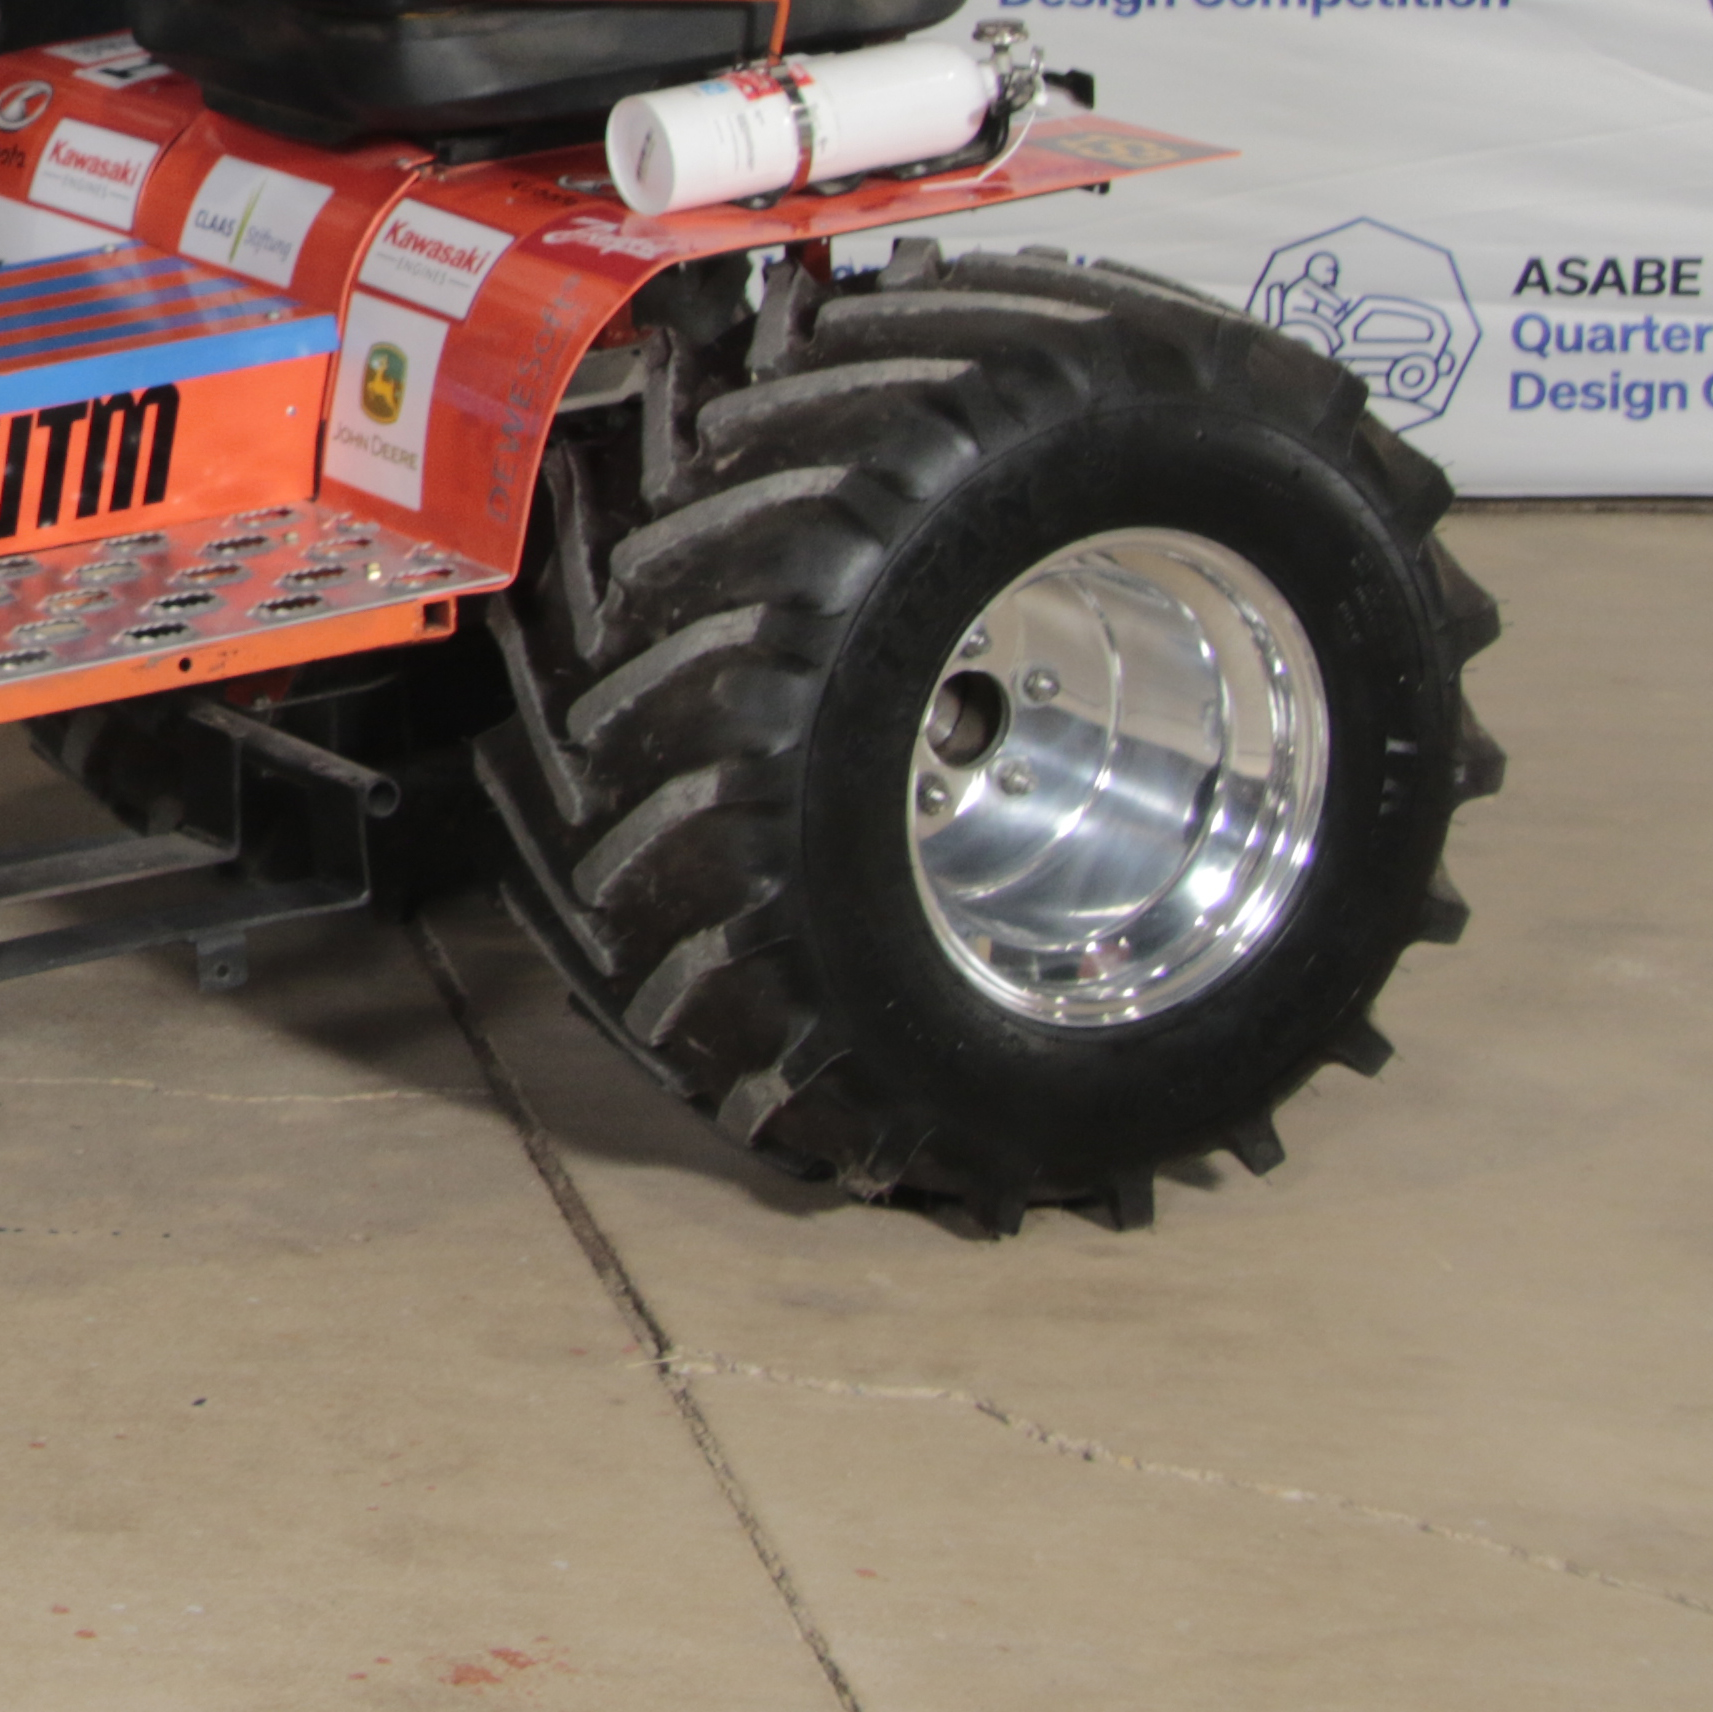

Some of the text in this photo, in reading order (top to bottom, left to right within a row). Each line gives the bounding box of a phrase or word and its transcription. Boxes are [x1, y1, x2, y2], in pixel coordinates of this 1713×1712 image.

[49, 139, 142, 187] Kawasaki
[194, 209, 237, 236] CLAAS
[382, 218, 493, 276] Kawasaki
[1514, 257, 1702, 296] ASABE
[1512, 313, 1713, 359] Quarter
[1510, 371, 1688, 421] Design
